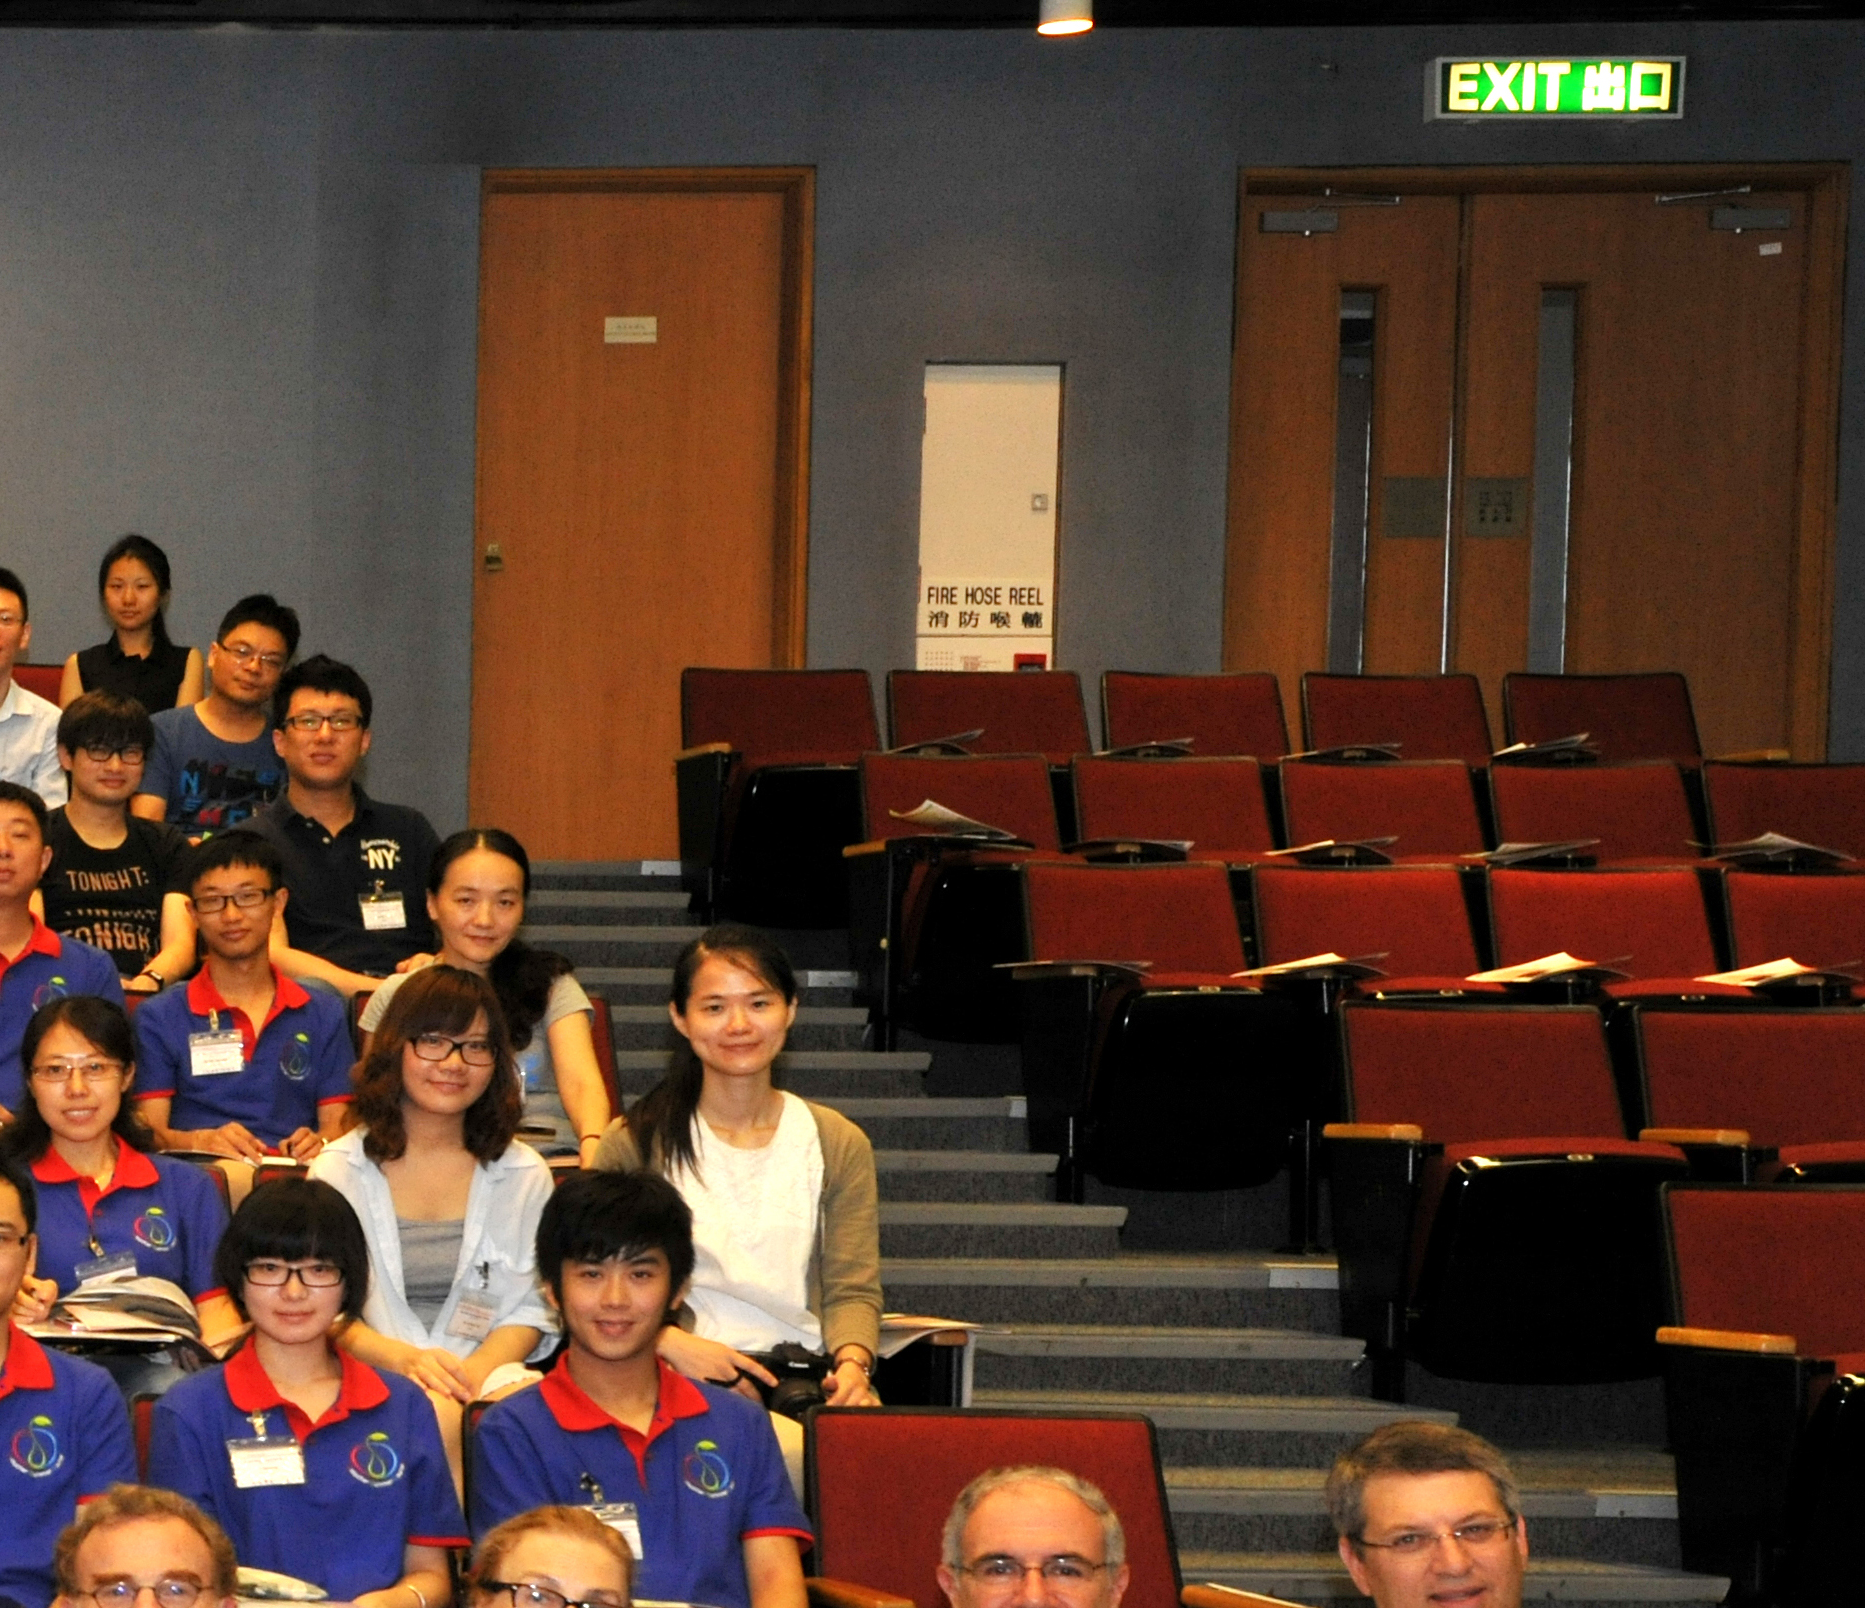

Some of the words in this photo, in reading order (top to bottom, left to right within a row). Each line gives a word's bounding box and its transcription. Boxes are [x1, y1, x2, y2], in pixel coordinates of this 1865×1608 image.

[1448, 62, 1571, 111] EXIT
[1582, 62, 1672, 111] 出口
[927, 586, 958, 605] FIRE
[965, 586, 1002, 605] HOSE
[1009, 587, 1044, 606] REEL
[928, 610, 1043, 629] 消防喉轆
[367, 848, 396, 870] NY
[66, 866, 149, 892] TONIGHT:
